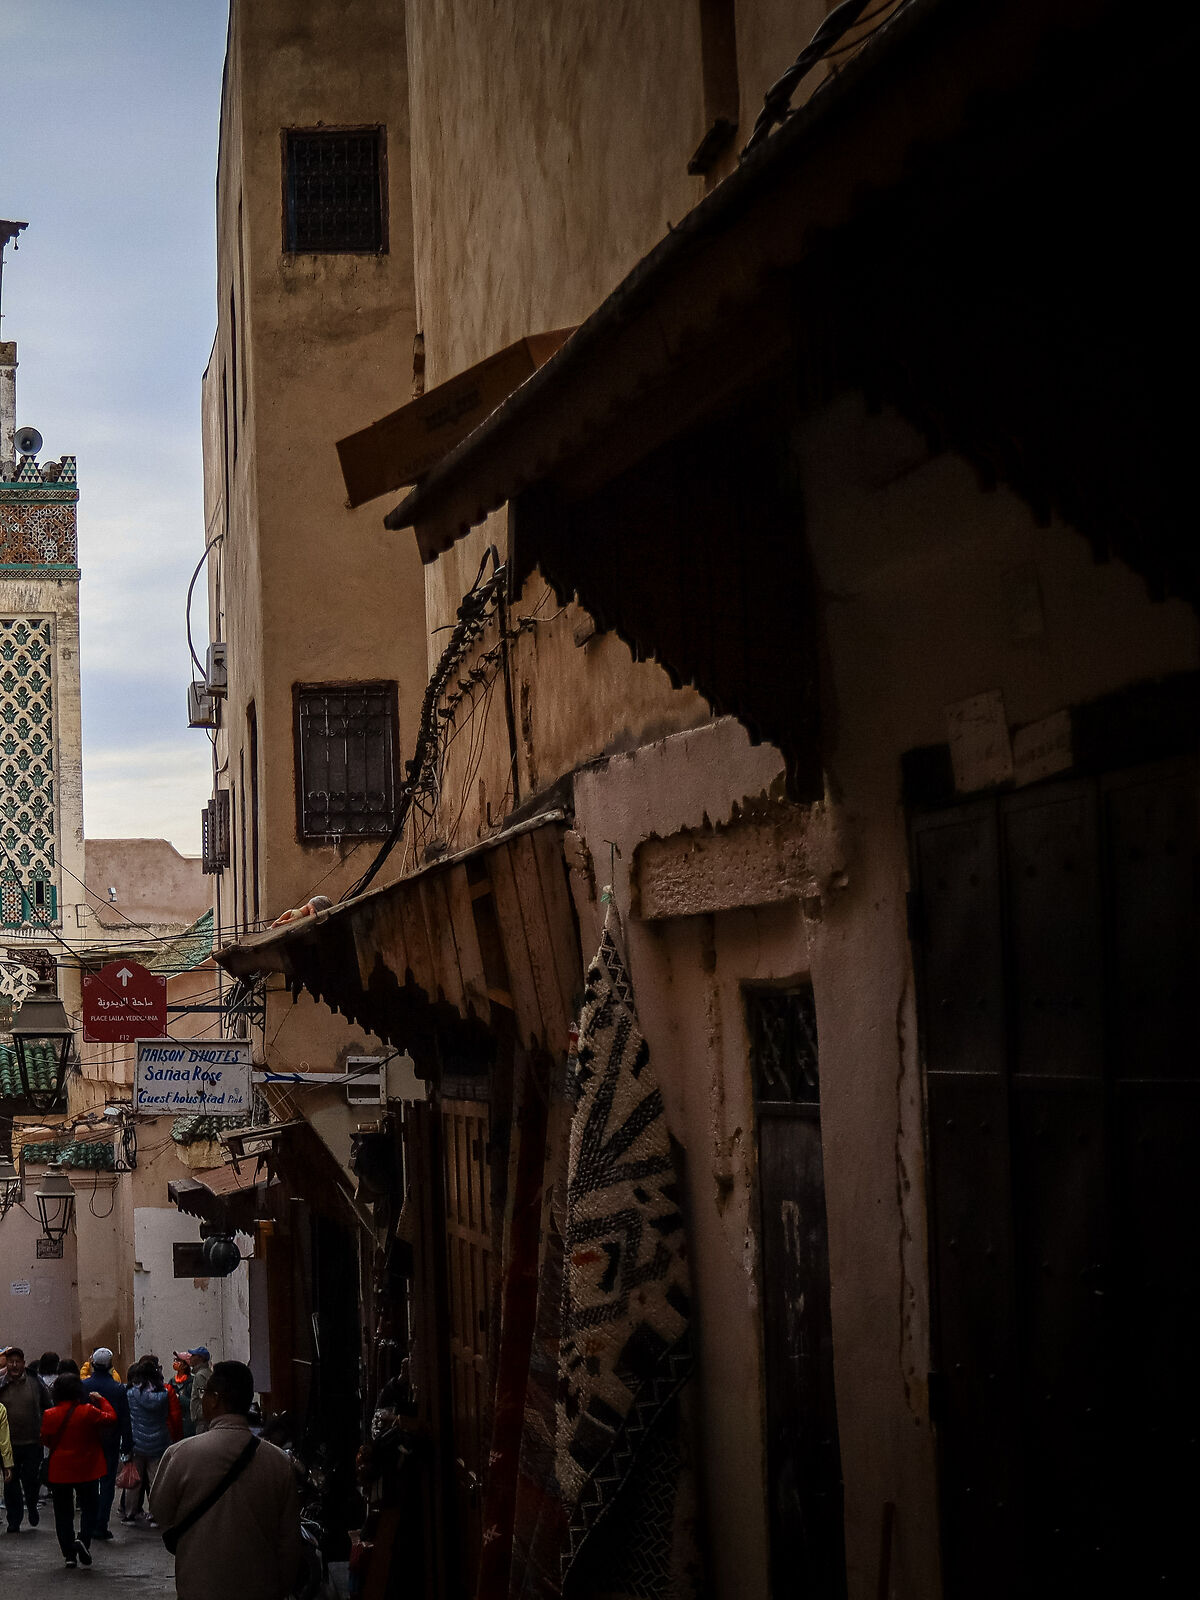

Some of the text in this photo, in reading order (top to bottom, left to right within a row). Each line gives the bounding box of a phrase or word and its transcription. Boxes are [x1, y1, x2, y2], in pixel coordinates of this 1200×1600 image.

[131, 997, 153, 1007] ساحة
[139, 1048, 241, 1063] MAISON D'HOTES
[145, 1066, 223, 1082] Sanaa Rose
[138, 1090, 171, 1104] Guest
[199, 1092, 226, 1104] Riad
[227, 1094, 243, 1104] Pink
